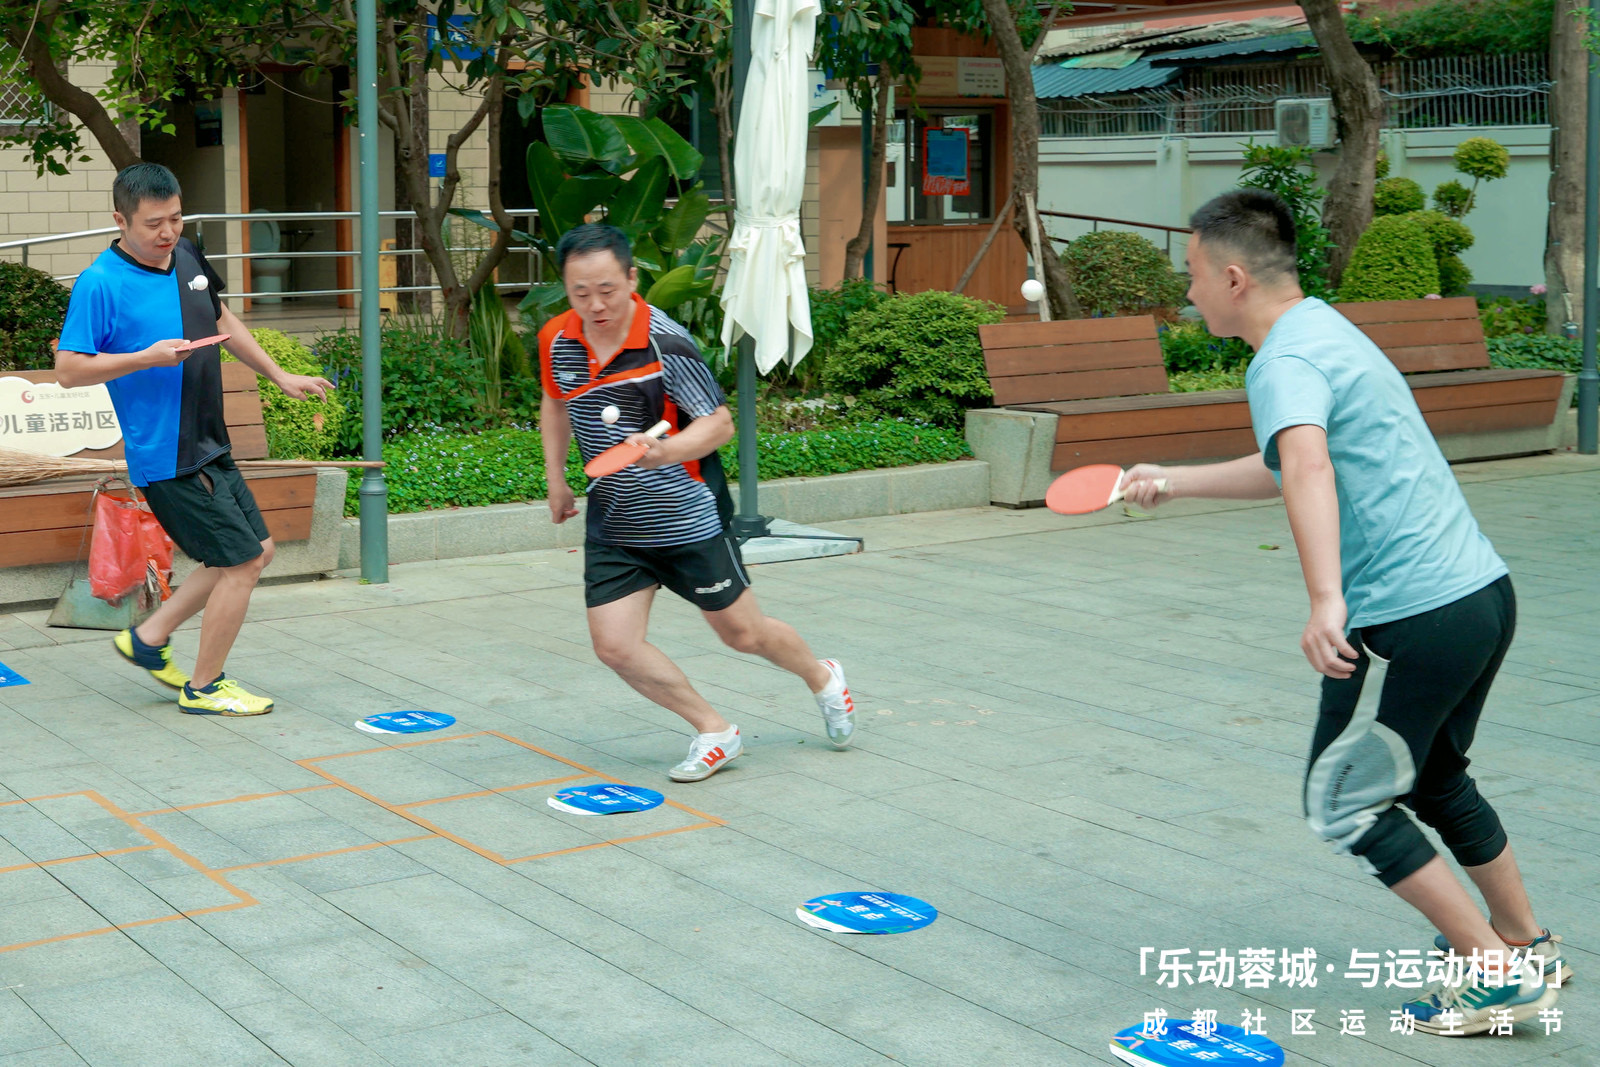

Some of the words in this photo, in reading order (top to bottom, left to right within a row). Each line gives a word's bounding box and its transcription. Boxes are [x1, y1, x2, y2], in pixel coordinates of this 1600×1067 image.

[3, 410, 116, 435] 儿童活动区
